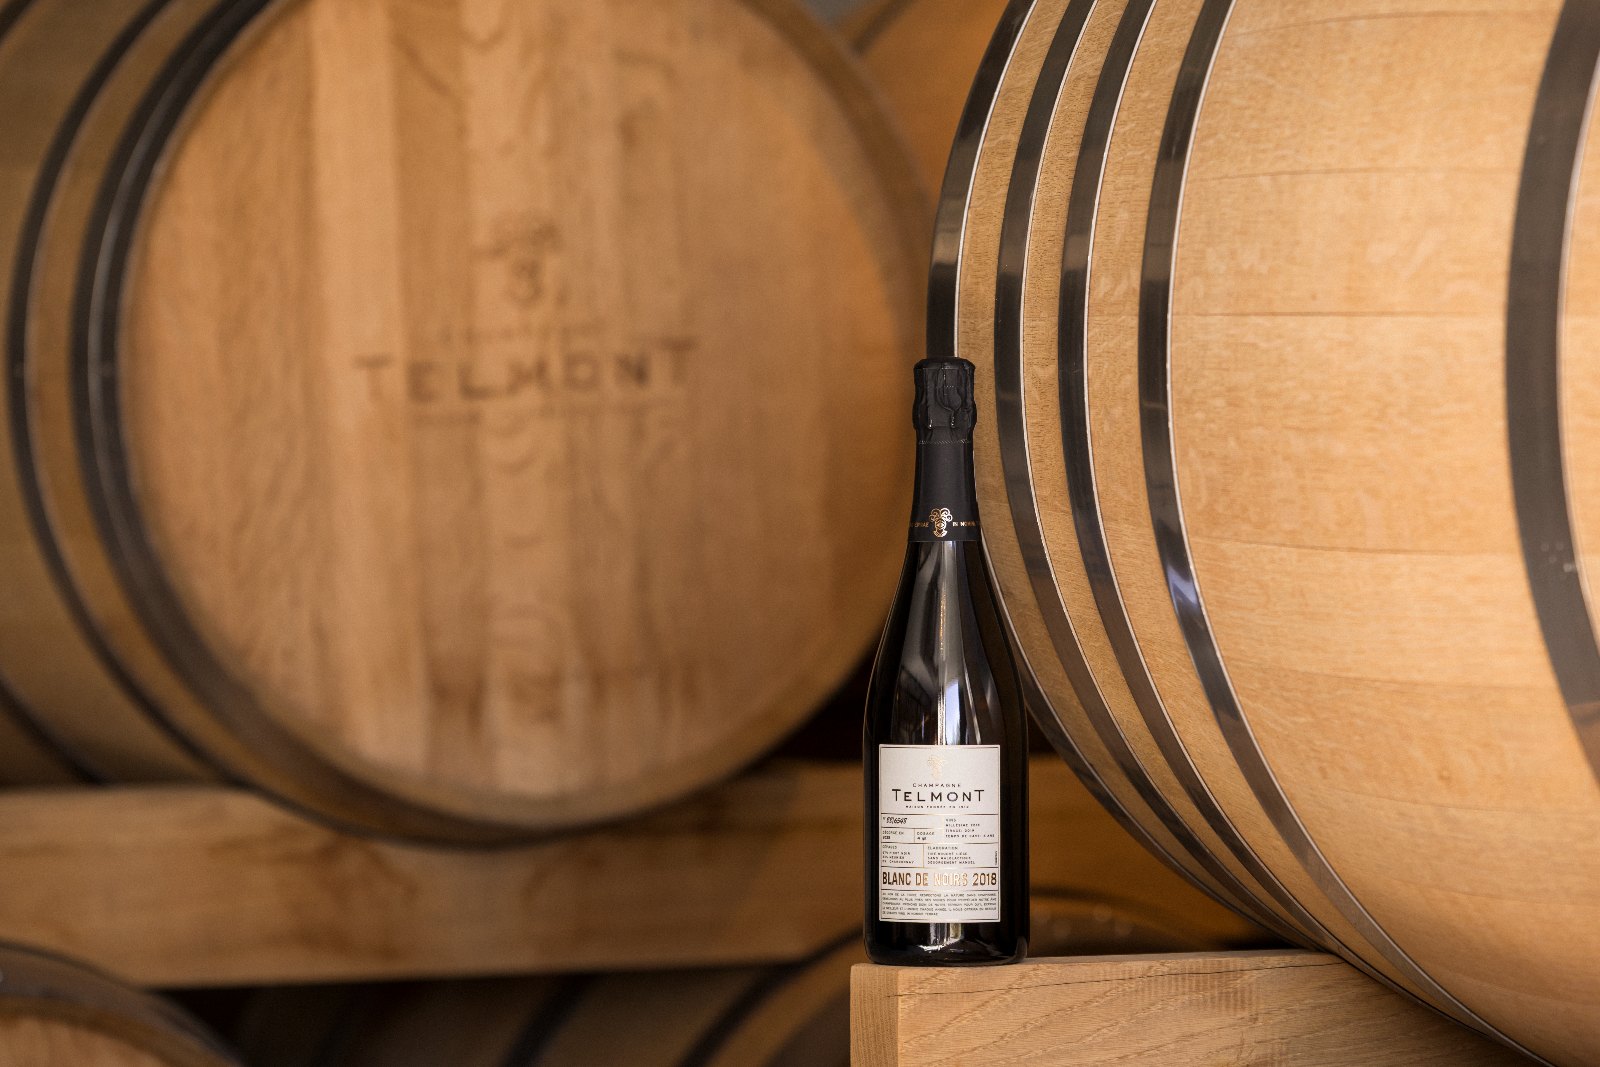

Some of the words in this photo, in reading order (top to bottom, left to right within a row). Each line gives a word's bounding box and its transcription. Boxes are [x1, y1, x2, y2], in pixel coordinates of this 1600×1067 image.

[354, 337, 699, 404] TELMONT
[892, 789, 984, 802] TELMONT
[883, 872, 911, 885] BLANC
[916, 872, 928, 886] DE
[934, 873, 968, 886] NOIRS
[973, 873, 996, 885] 2018
